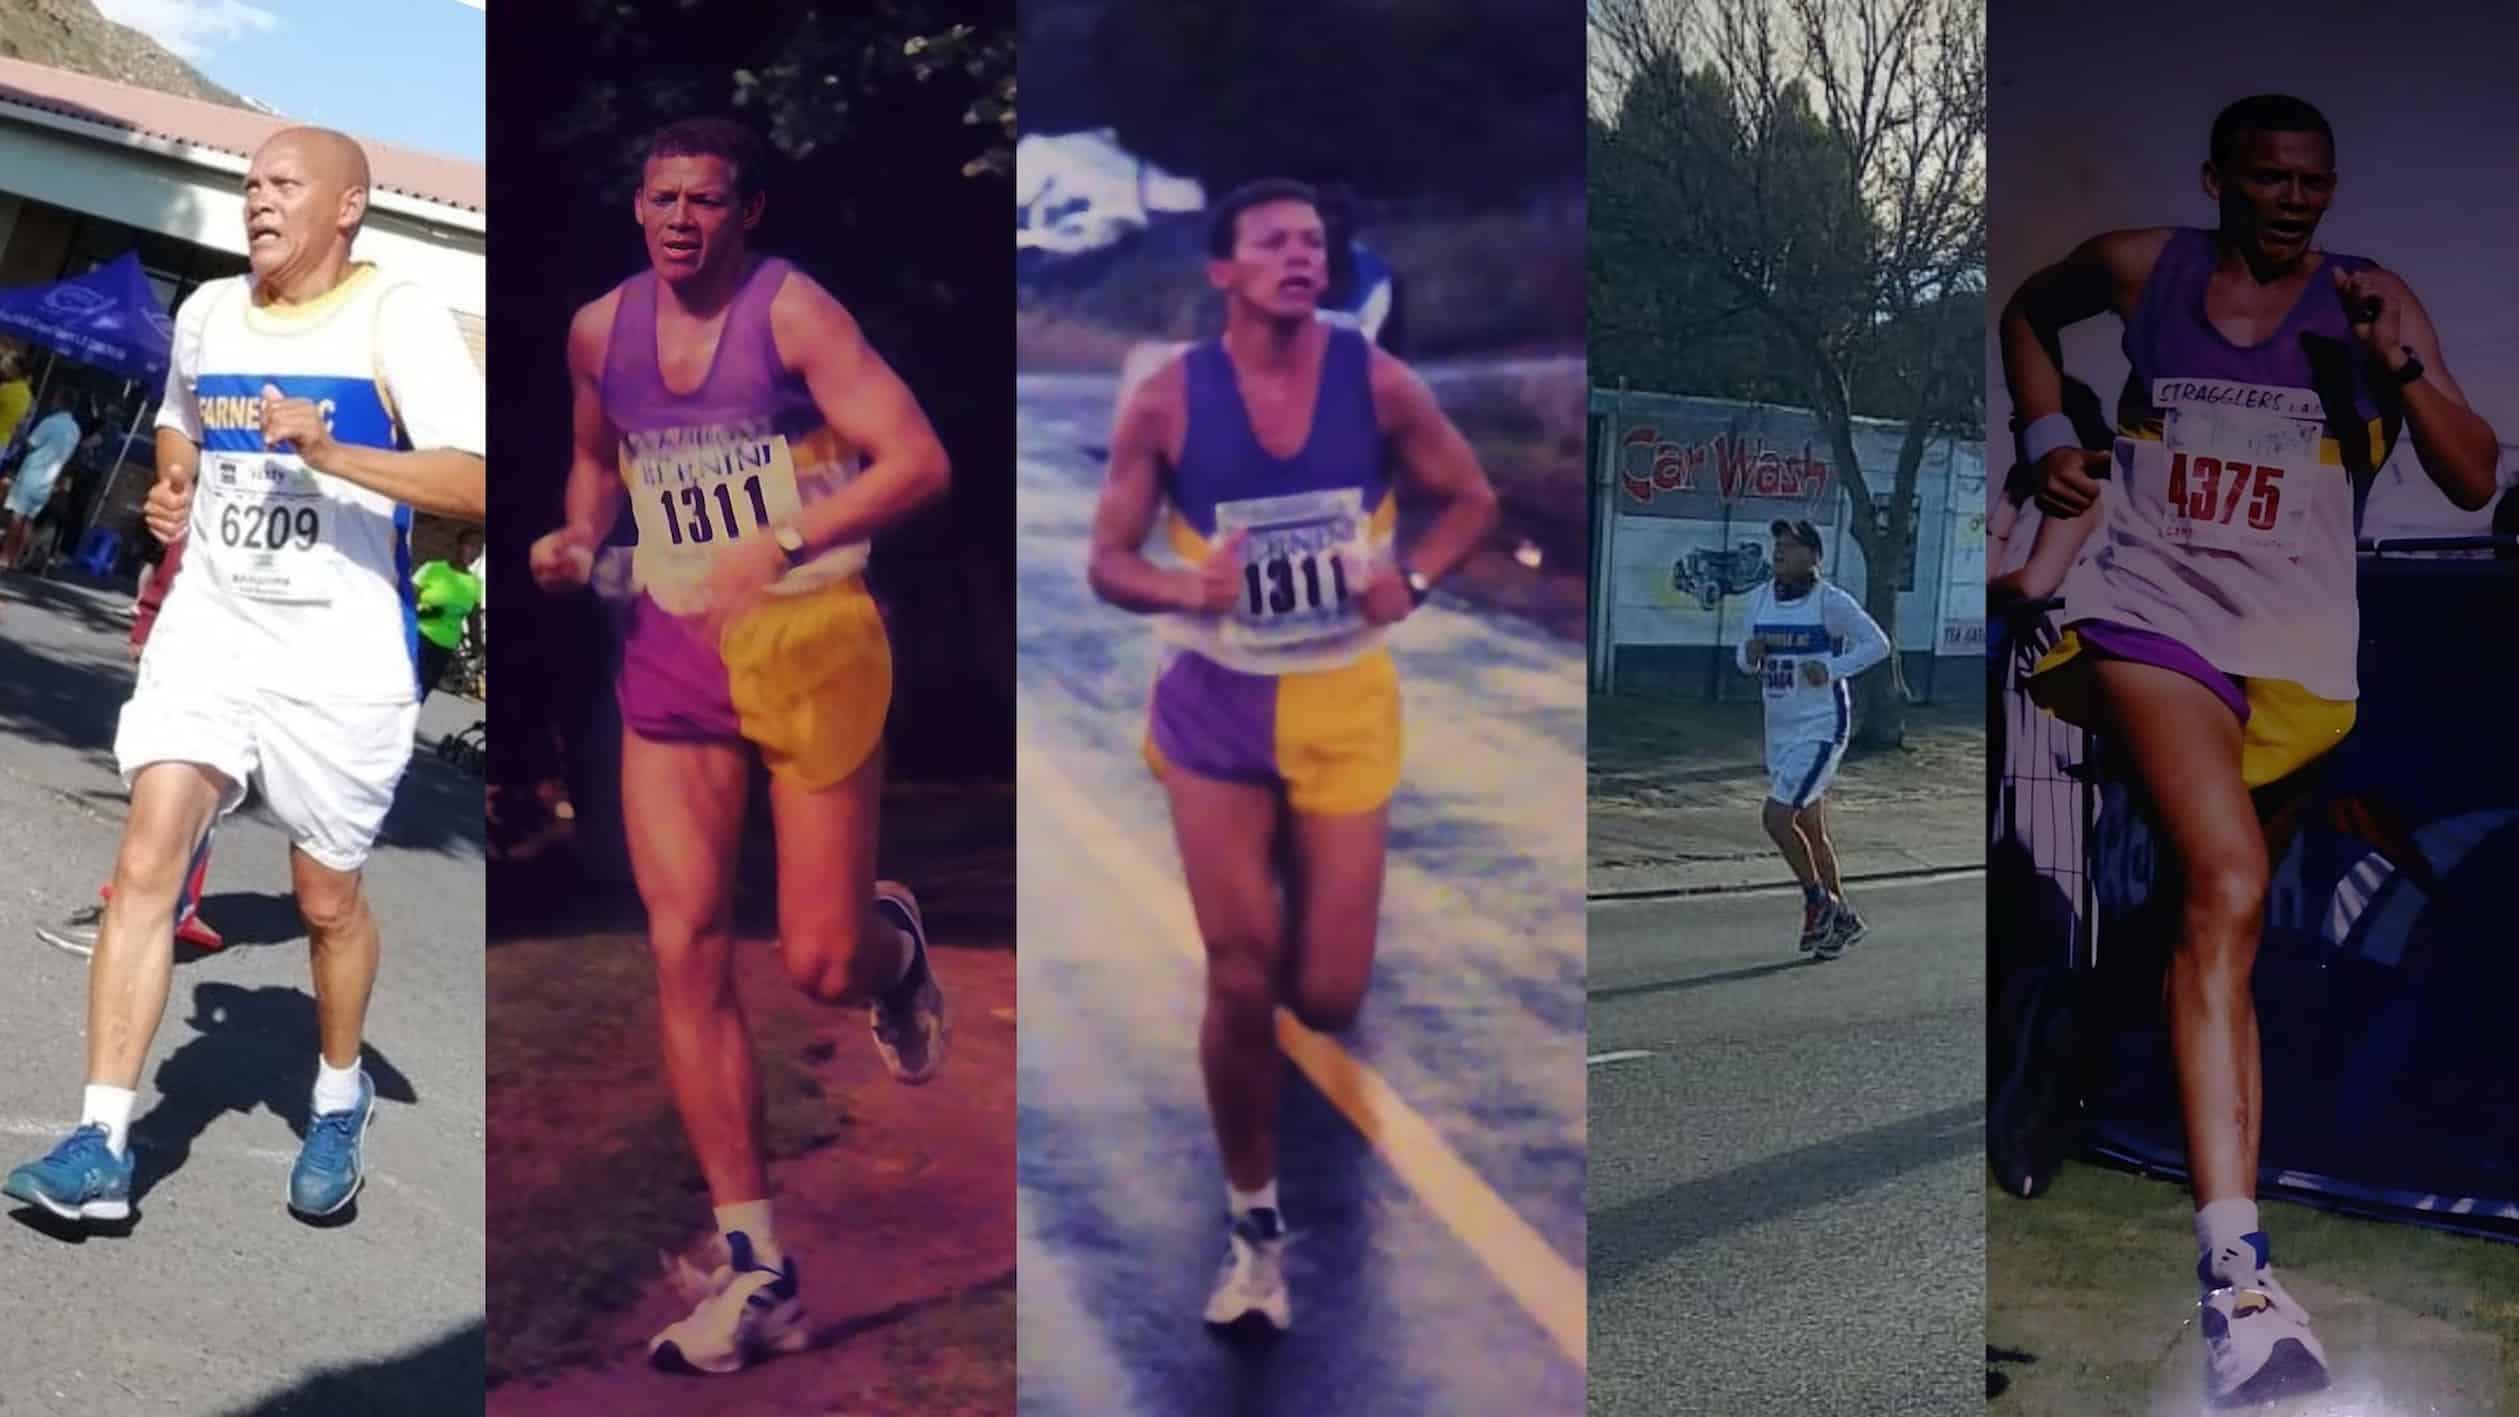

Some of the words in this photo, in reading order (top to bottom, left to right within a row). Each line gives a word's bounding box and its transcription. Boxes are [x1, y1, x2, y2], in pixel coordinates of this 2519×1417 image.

[2159, 382, 2285, 412] STRAGGLERS
[1622, 425, 1707, 503] Car
[1710, 431, 1834, 506] Wash
[2168, 453, 2285, 531] 4375
[220, 503, 319, 551] 6209
[661, 475, 770, 545] 1311
[1245, 554, 1348, 615] 1311
